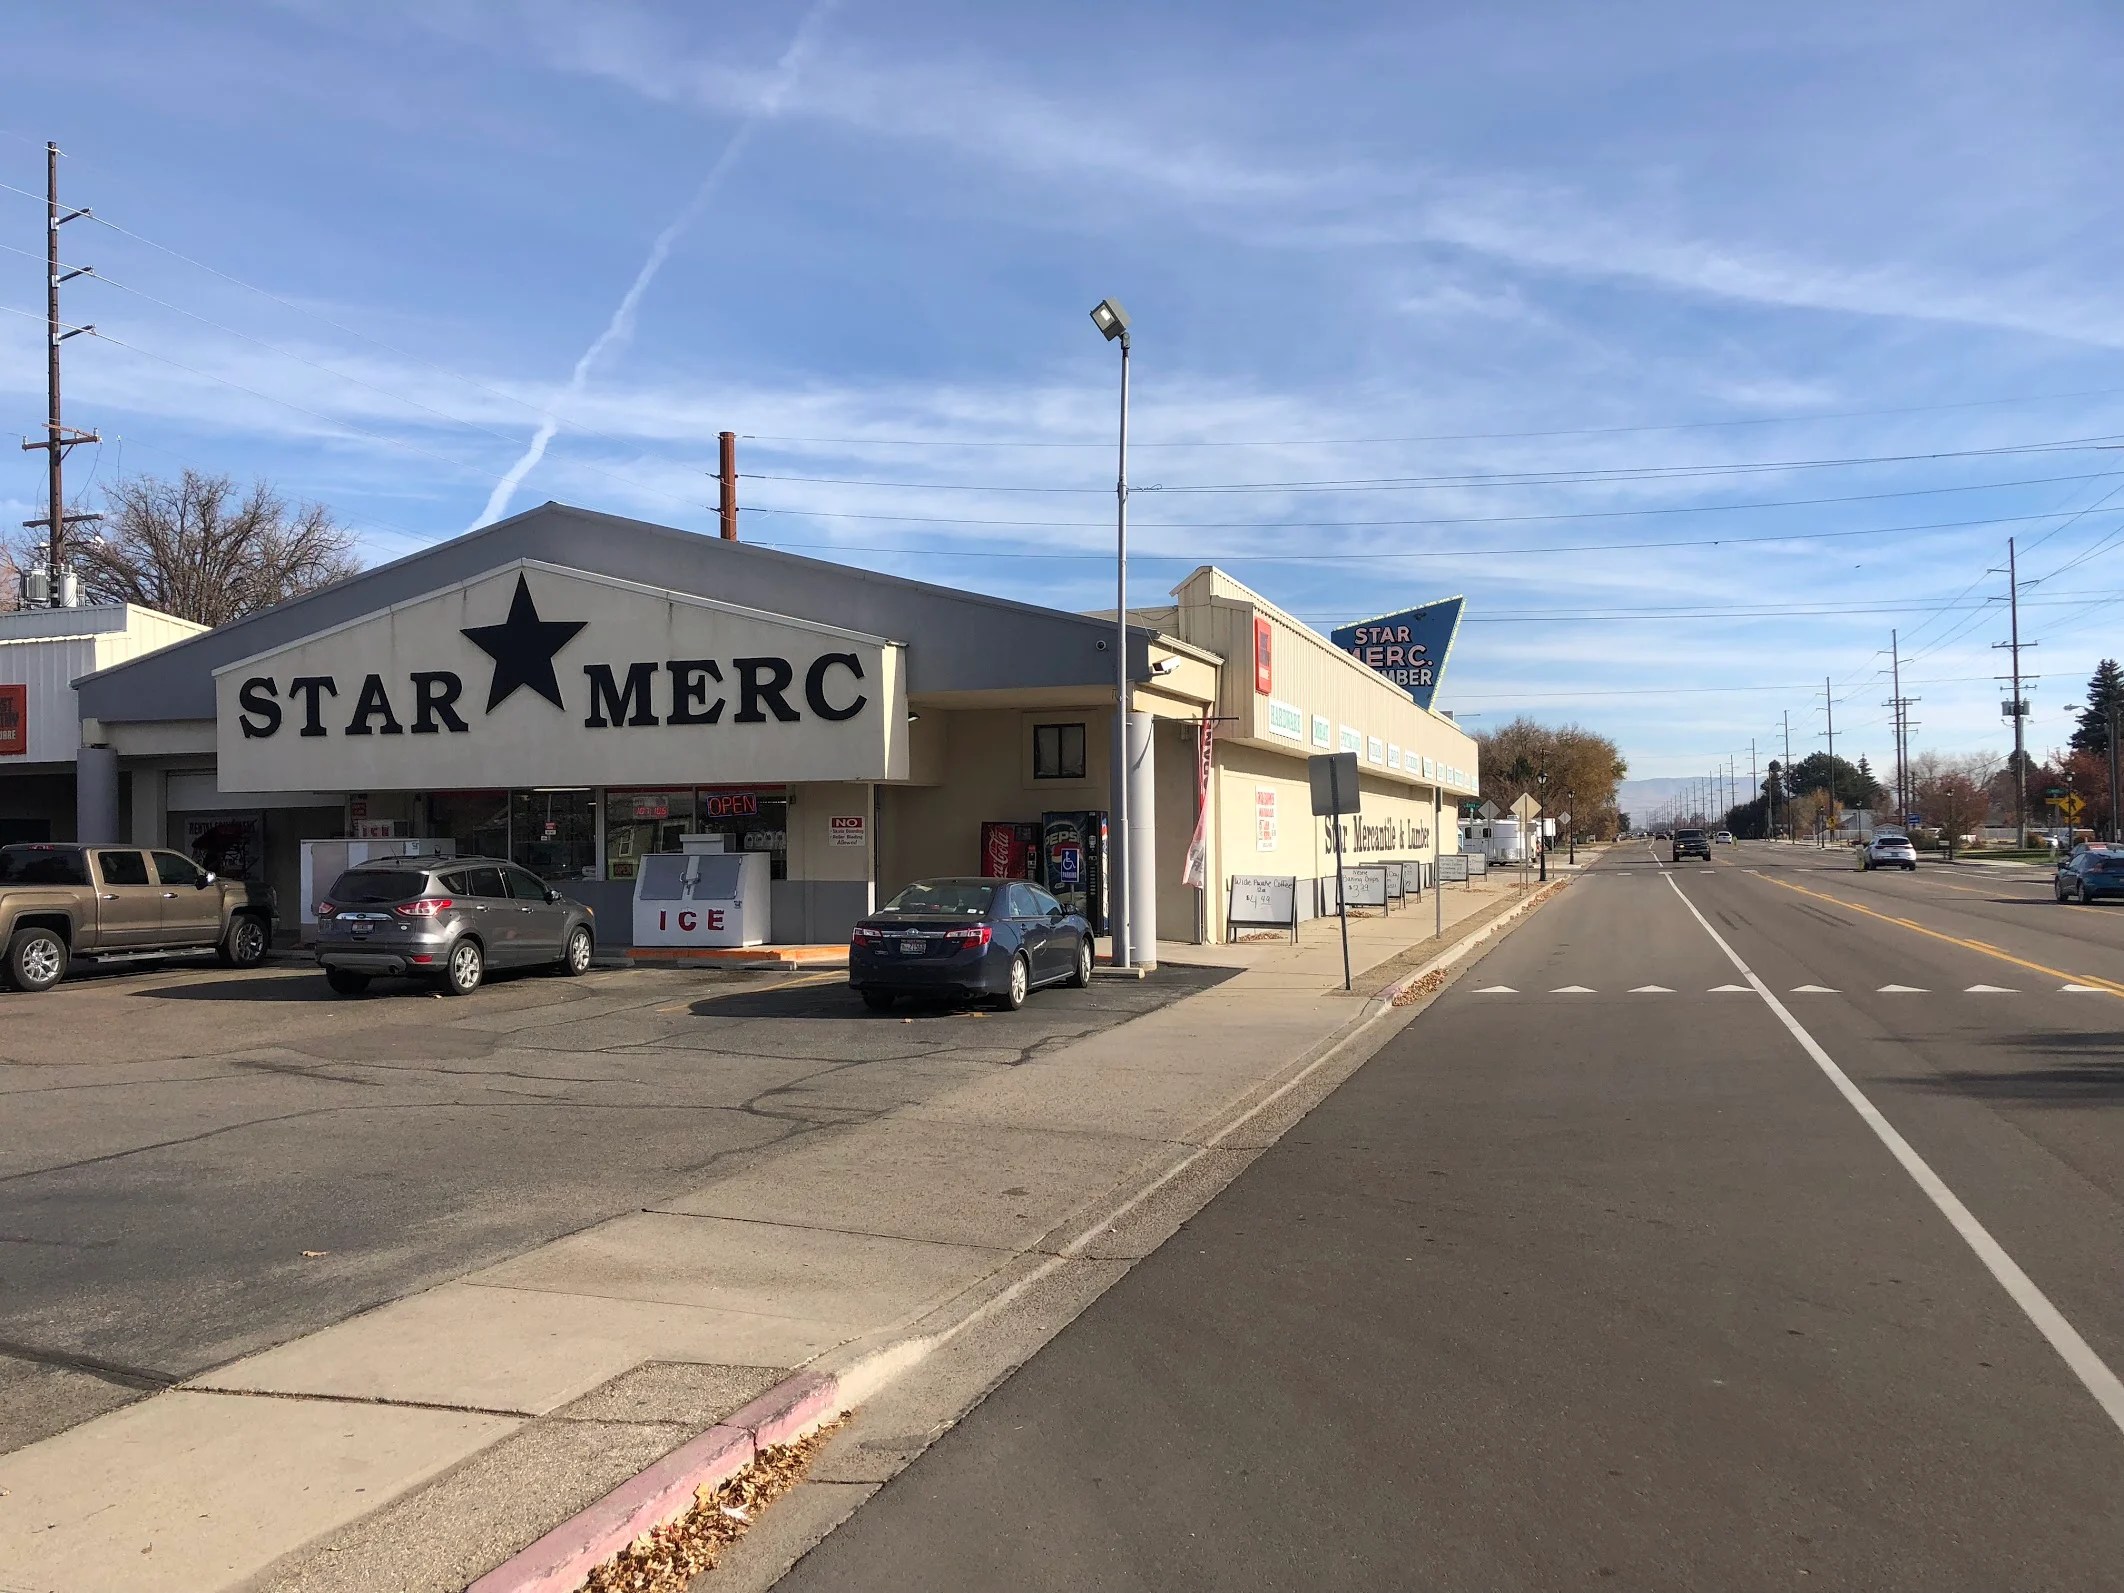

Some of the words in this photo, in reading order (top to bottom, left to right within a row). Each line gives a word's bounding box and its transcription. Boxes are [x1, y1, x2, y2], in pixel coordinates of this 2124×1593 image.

[1355, 626, 1411, 645] STAR
[1380, 669, 1432, 686] MBER
[239, 671, 469, 738] STAR
[584, 653, 868, 729] MERC
[709, 795, 756, 815] OPEN
[836, 818, 858, 827] NO
[1353, 815, 1396, 853] Mercantile
[1400, 818, 1405, 849] &
[1408, 818, 1430, 850] Lumber
[990, 828, 1009, 878] ca-Cola
[1234, 877, 1252, 887] Wide
[1273, 878, 1293, 890] Coffee
[659, 908, 725, 931] ICE
